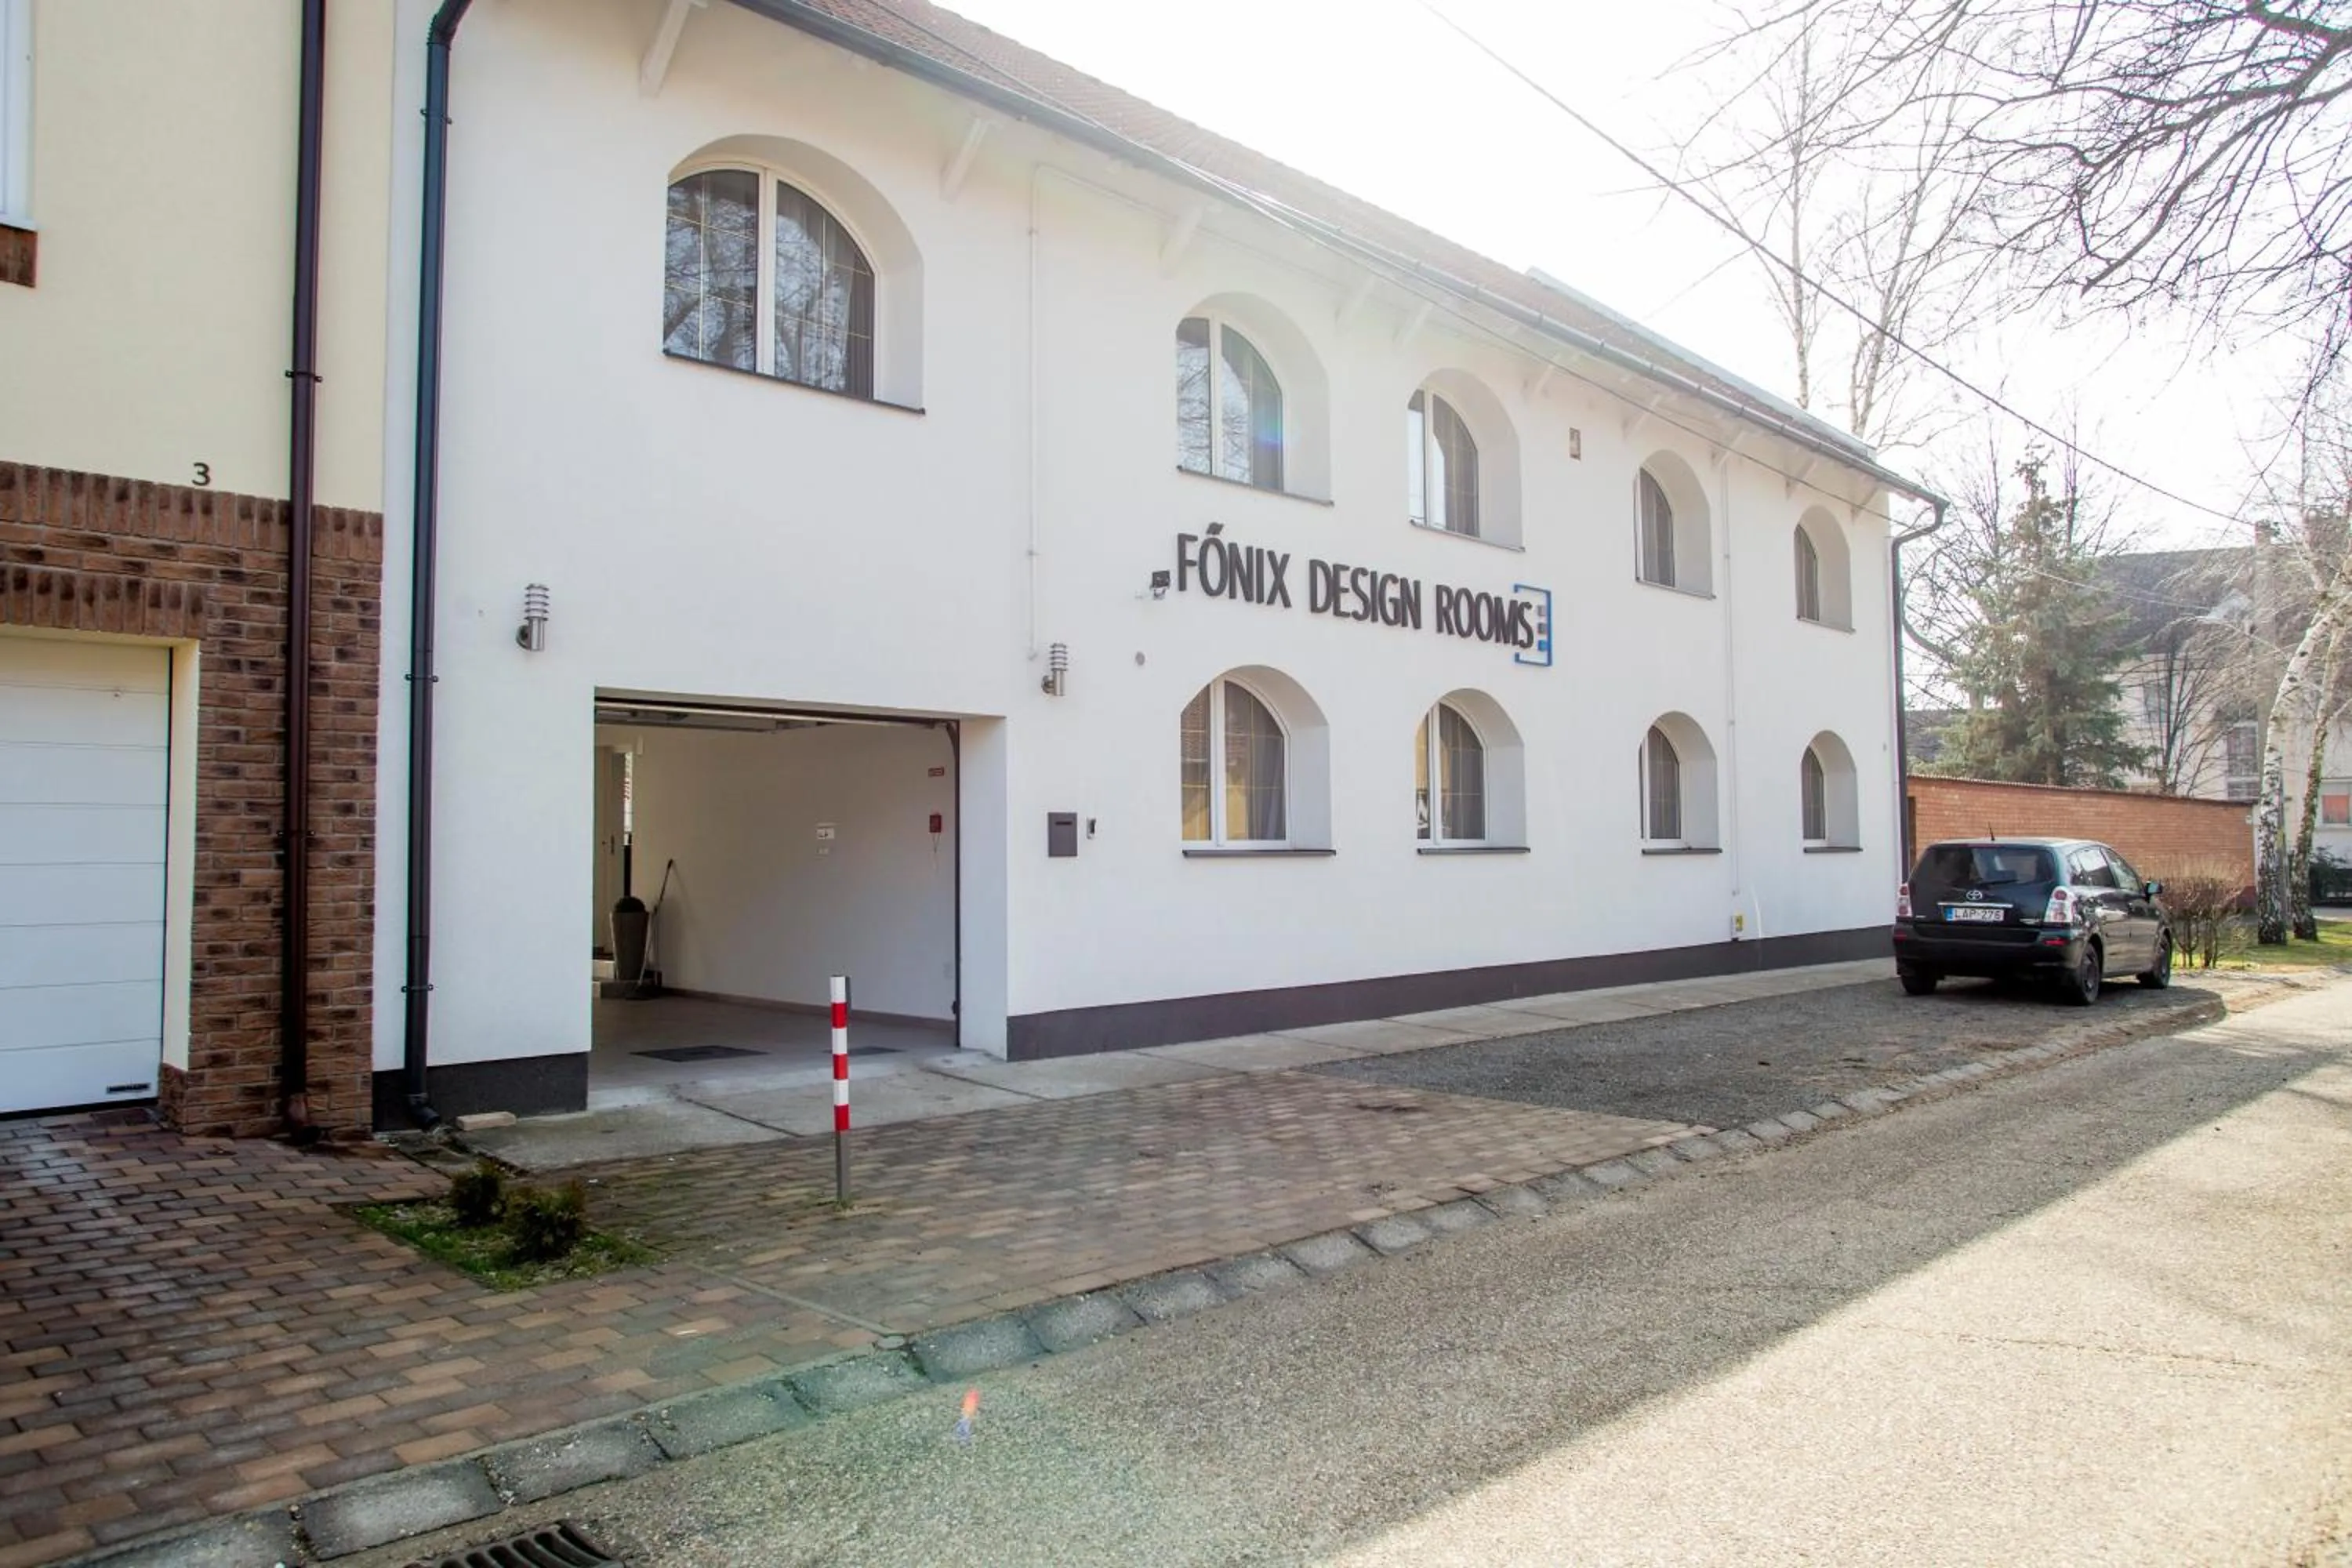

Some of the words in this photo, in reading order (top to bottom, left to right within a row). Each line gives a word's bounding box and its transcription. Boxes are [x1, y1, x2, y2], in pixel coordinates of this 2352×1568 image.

[192, 462, 210, 486] 3
[1308, 558, 1421, 630] DESIGN
[1436, 584, 1534, 649] ROOMS
